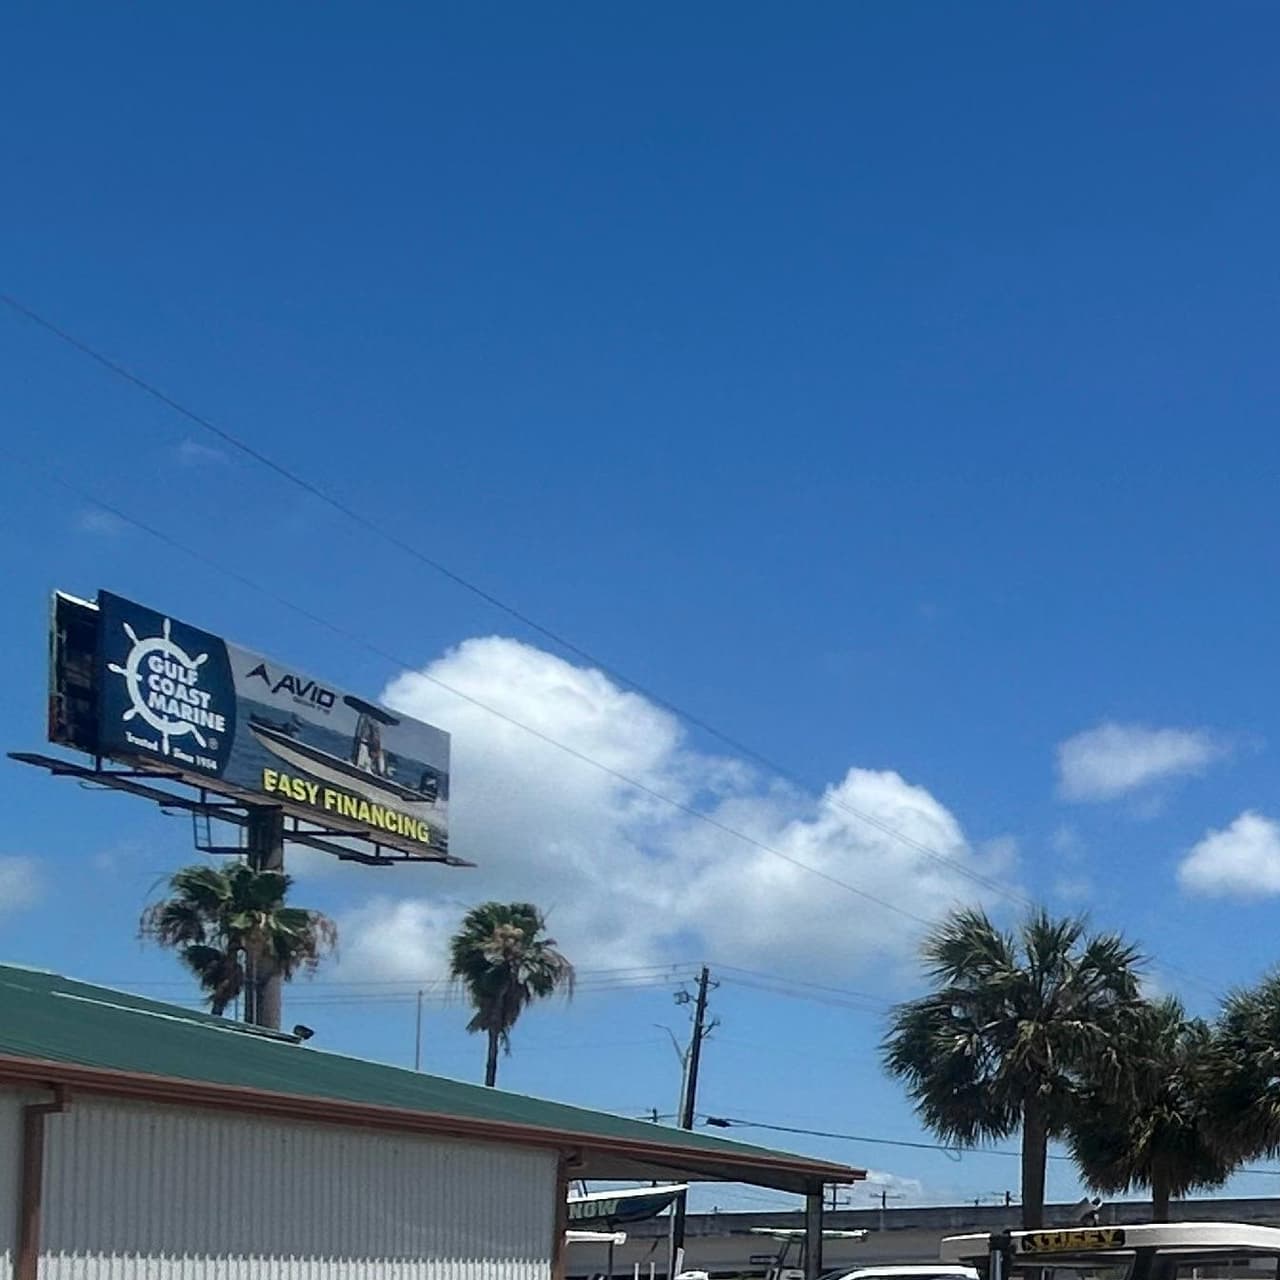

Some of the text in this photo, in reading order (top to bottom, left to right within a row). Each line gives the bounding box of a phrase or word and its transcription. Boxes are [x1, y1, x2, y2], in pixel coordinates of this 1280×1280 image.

[147, 654, 199, 687] GULF
[147, 673, 212, 709] COAST
[271, 674, 336, 709] AVID
[149, 691, 226, 733] MARINE
[262, 767, 431, 844] EASY FINANCING
